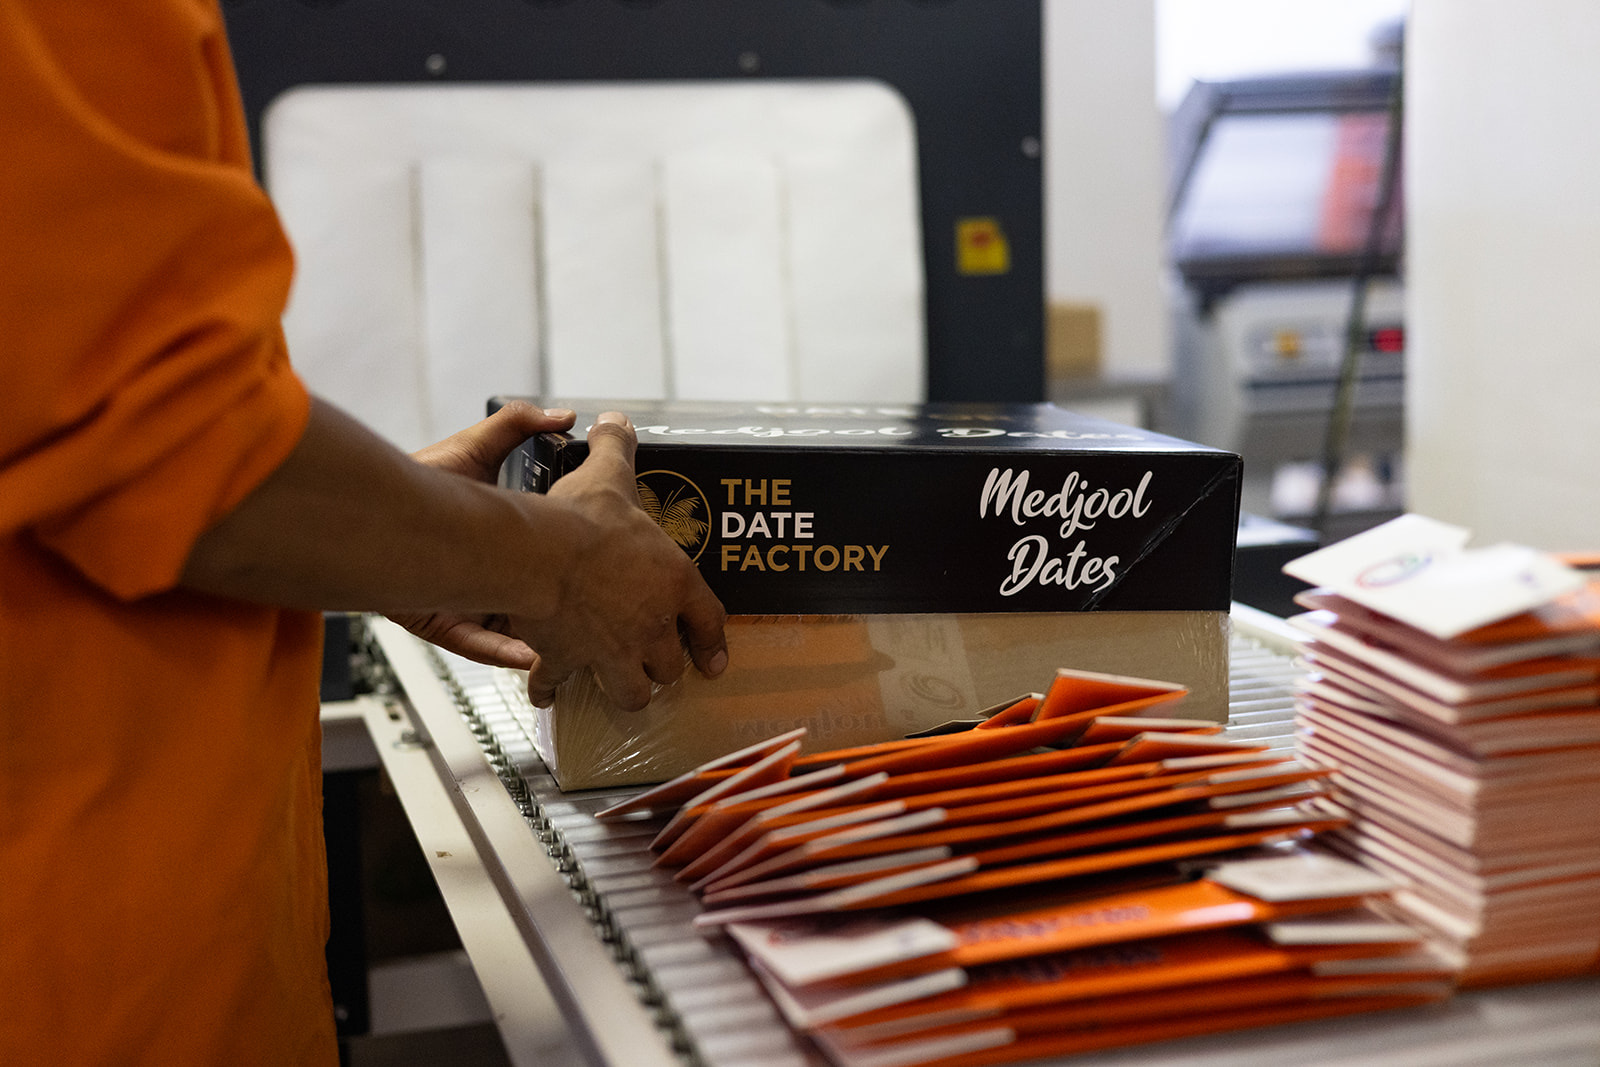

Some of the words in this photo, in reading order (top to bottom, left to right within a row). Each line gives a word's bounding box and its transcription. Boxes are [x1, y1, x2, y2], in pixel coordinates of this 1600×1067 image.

[721, 478, 792, 506] THE
[980, 468, 1153, 538] Medjool
[721, 511, 815, 539] DATE
[721, 545, 889, 572] FACTORY
[1000, 535, 1119, 596] Dates
